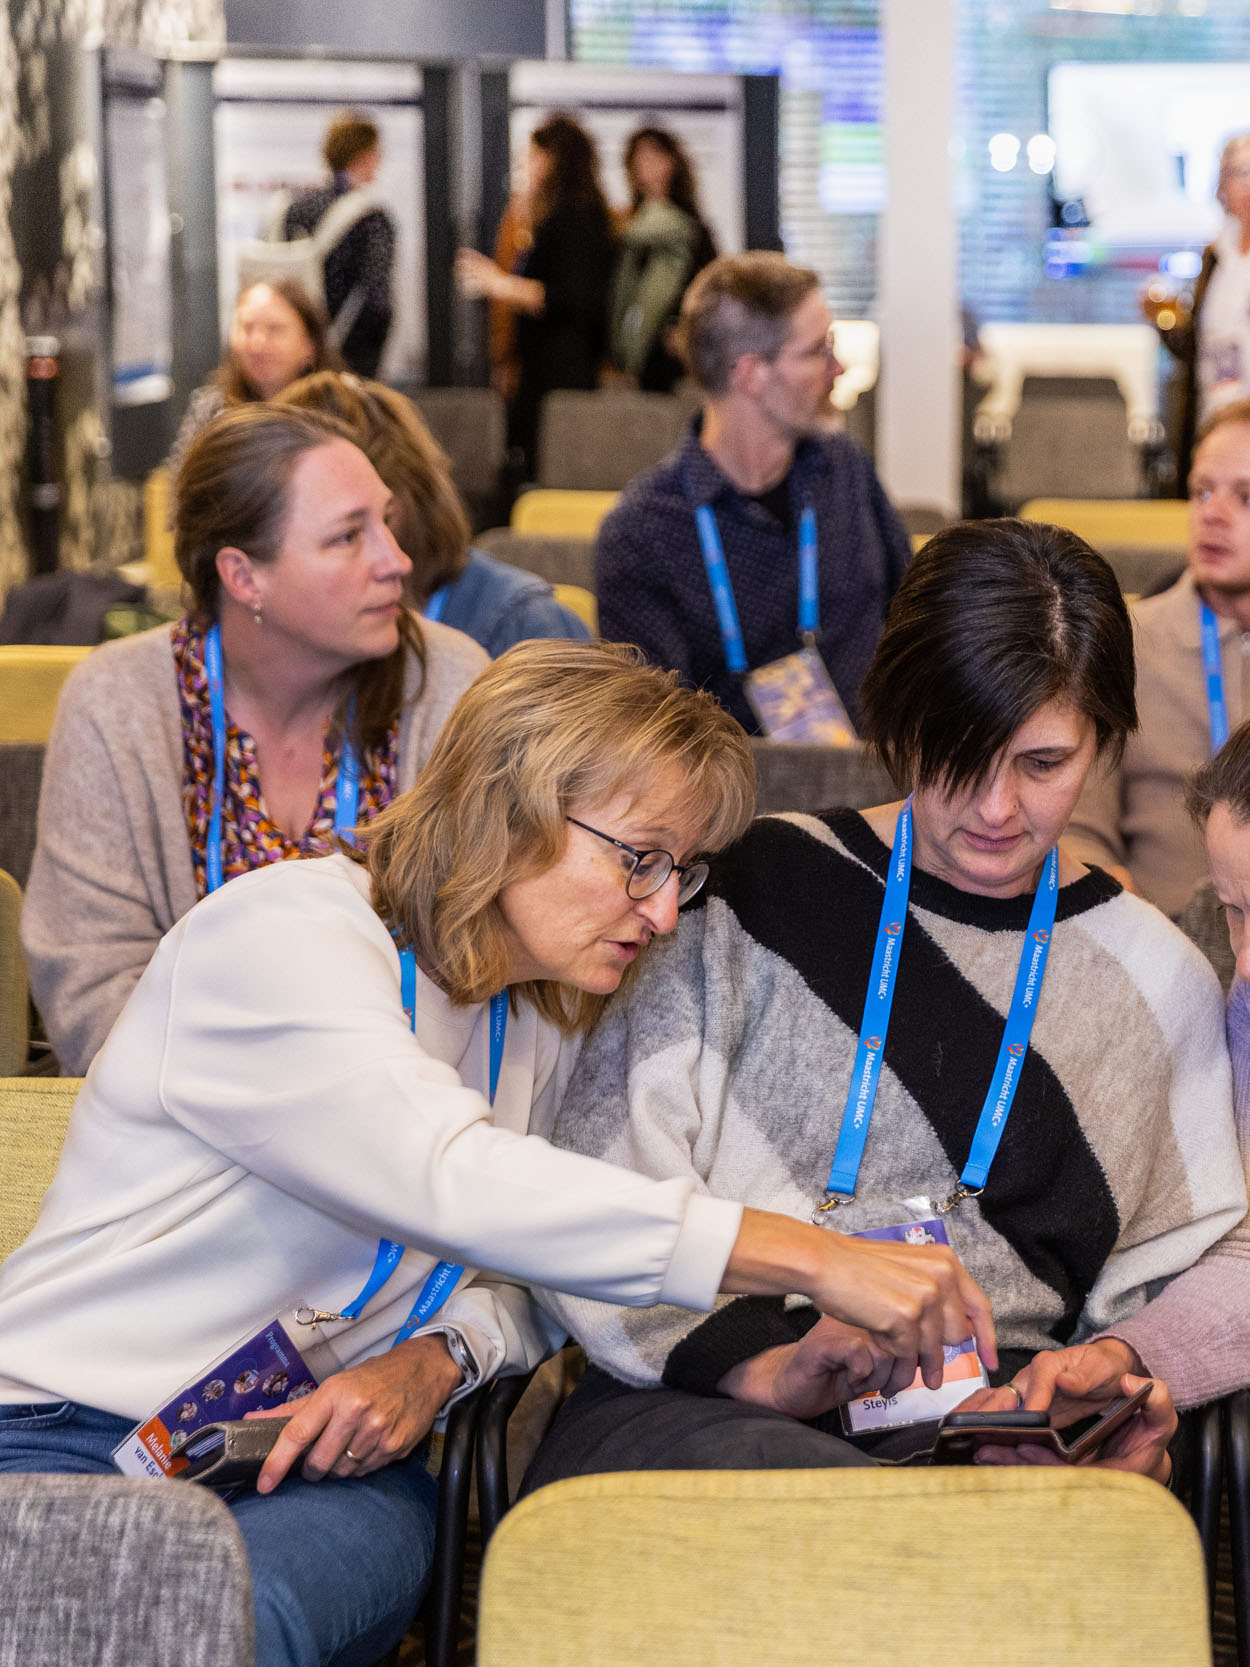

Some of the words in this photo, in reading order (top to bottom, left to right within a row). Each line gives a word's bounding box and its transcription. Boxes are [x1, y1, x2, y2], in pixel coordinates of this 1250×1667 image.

[881, 937, 896, 978] Maastricht
[1026, 944, 1043, 986] Maastricht
[877, 978, 889, 1000] UMC+
[1022, 987, 1035, 1008] UMC+
[858, 1051, 876, 1100] Maastricht
[999, 1056, 1018, 1100] Maastricht
[853, 1101, 867, 1129] UMC+
[991, 1100, 1007, 1127] UMC+
[387, 1242, 400, 1264] MC+
[418, 1267, 451, 1315] Maastricht
[265, 1331, 290, 1368] Programma
[134, 1446, 148, 1465] van
[145, 1432, 172, 1470] Melanie
